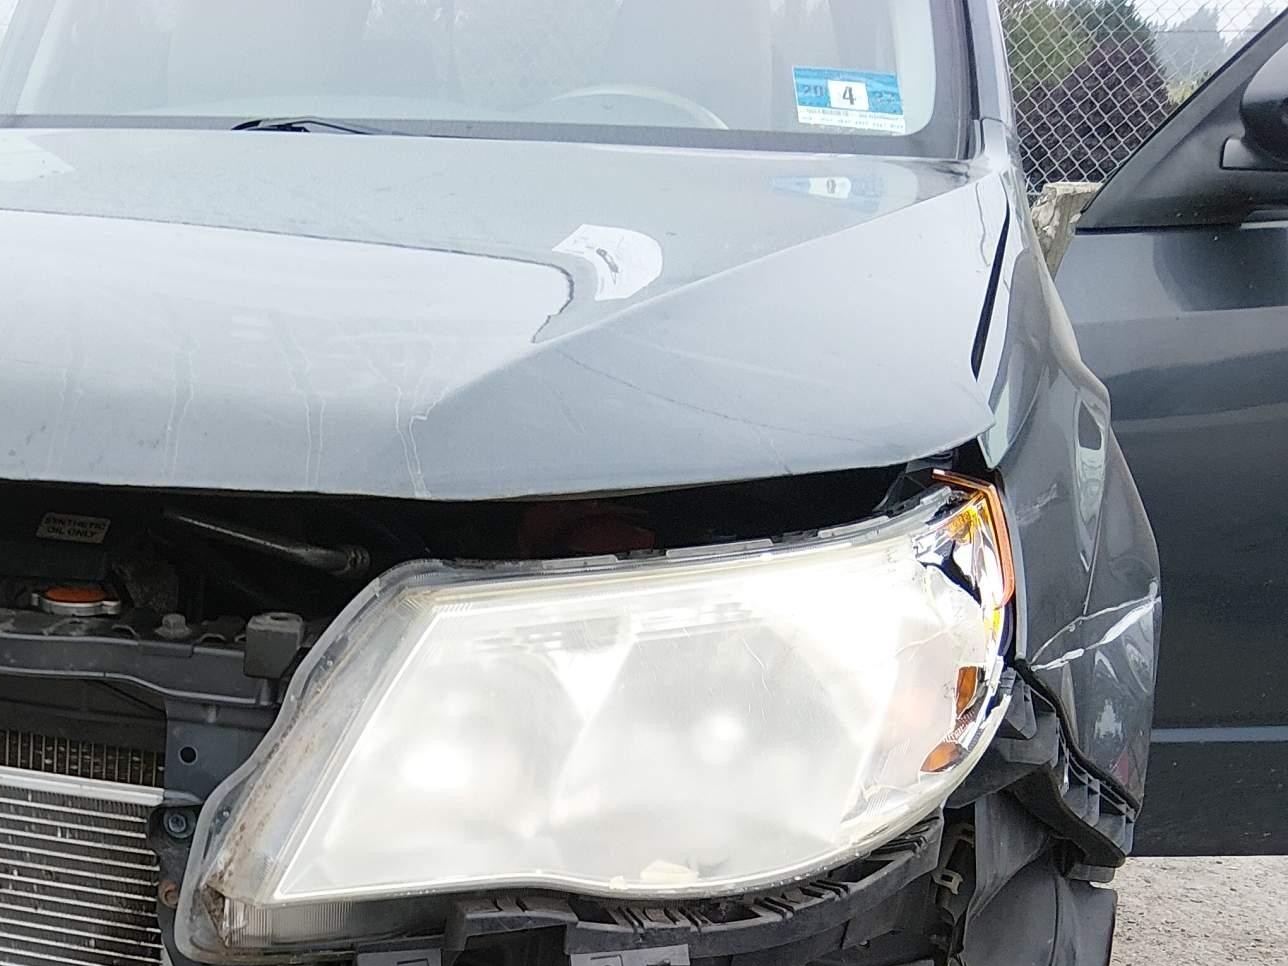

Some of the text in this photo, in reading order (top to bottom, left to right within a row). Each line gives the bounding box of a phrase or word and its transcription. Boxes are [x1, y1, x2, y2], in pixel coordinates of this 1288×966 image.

[842, 86, 856, 105] 4
[47, 526, 97, 538] OIL ONLY
